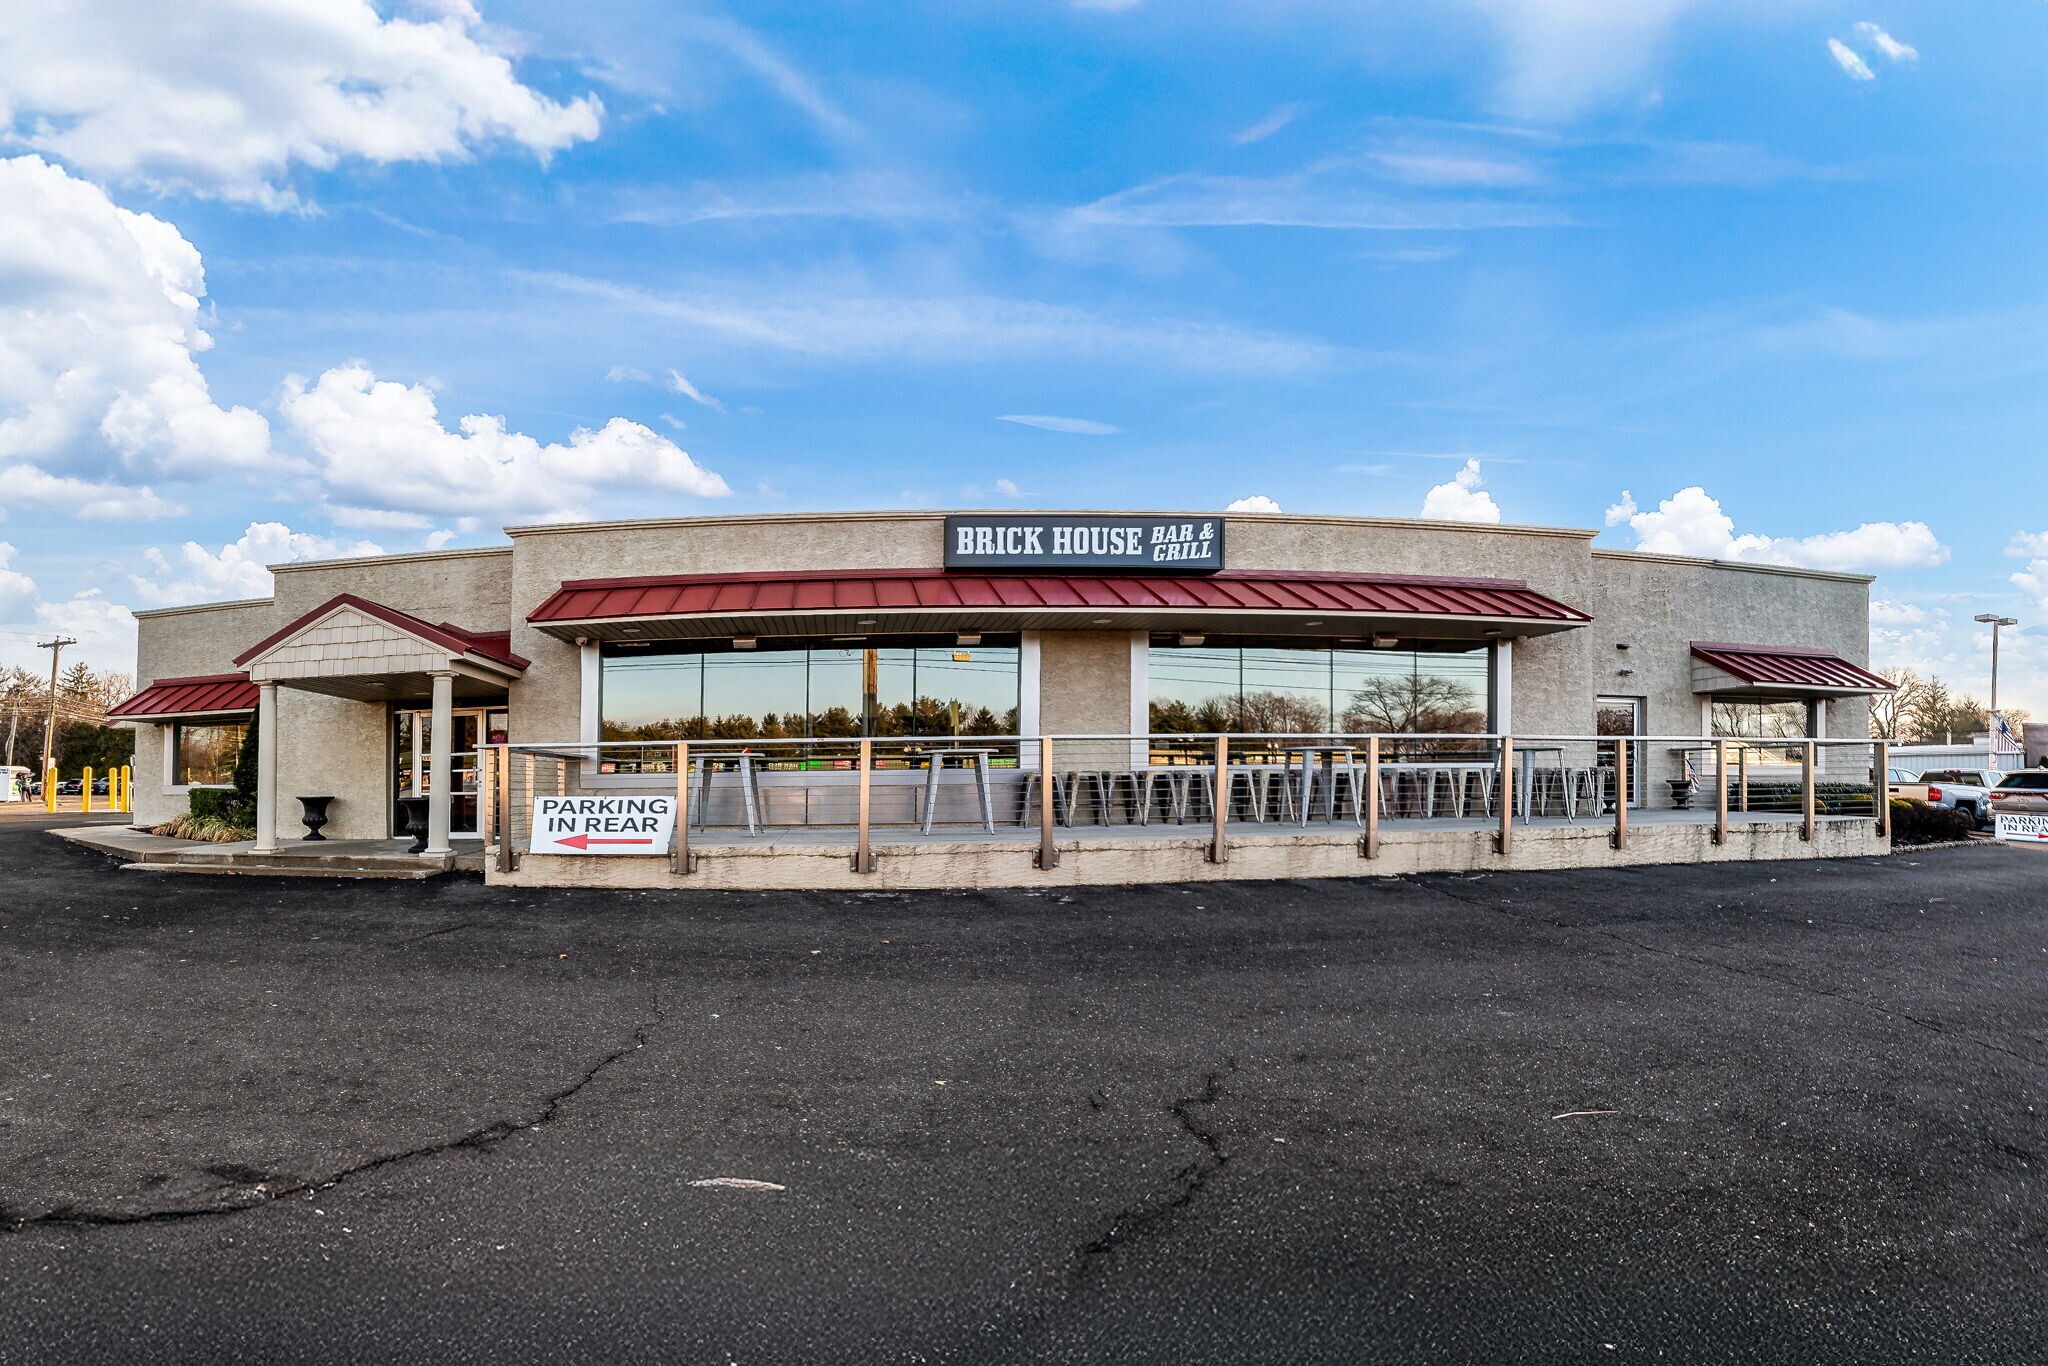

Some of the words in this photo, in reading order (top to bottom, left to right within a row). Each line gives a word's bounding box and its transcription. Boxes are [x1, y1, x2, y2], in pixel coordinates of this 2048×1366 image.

[956, 526, 1044, 555] BRICK
[1052, 526, 1143, 555] HOUSE
[1150, 525, 1194, 544] BAR
[1199, 522, 1215, 541] &
[1152, 540, 1213, 562] GRILL
[542, 799, 669, 815] PARKING
[548, 817, 576, 832] IN
[584, 817, 659, 833] REAR
[2000, 815, 2048, 825] PARKIN
[2003, 823, 2018, 832] IN
[2021, 824, 2048, 833] REA
